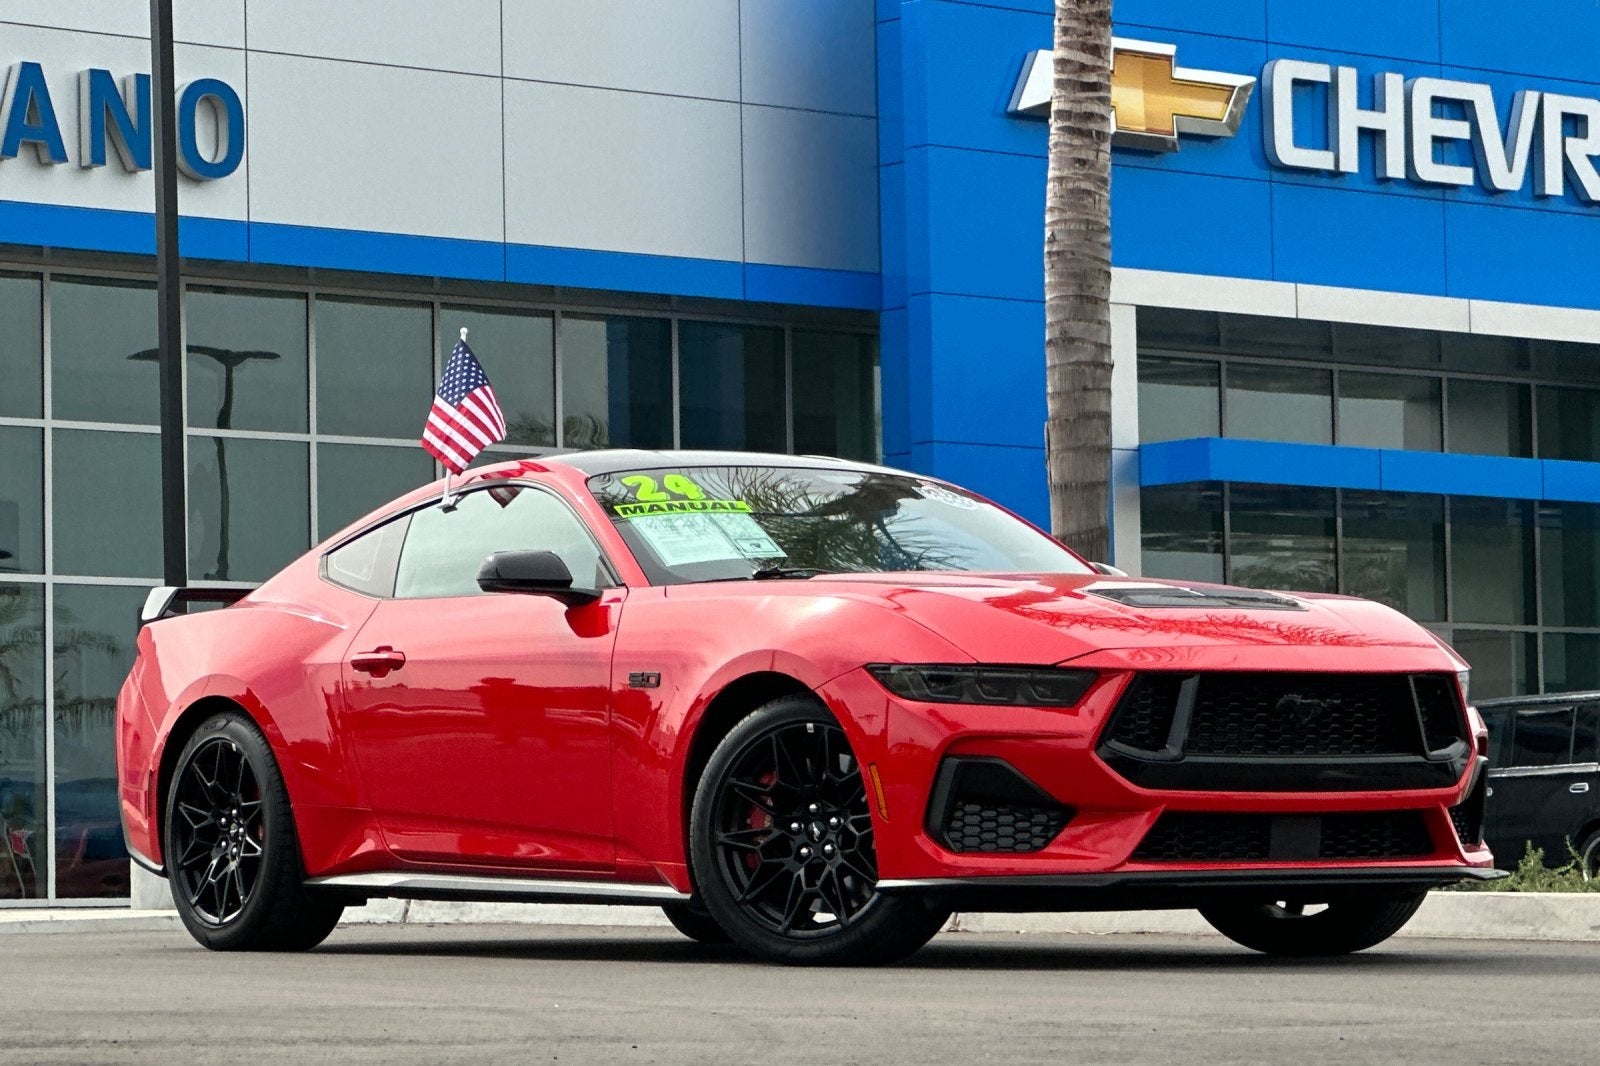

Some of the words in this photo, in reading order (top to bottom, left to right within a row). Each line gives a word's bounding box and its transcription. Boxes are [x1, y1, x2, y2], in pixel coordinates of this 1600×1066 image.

[0, 61, 245, 180] ANO
[1261, 58, 1600, 202] CHEVR
[619, 501, 747, 516] MANUAL
[621, 474, 706, 501] 24
